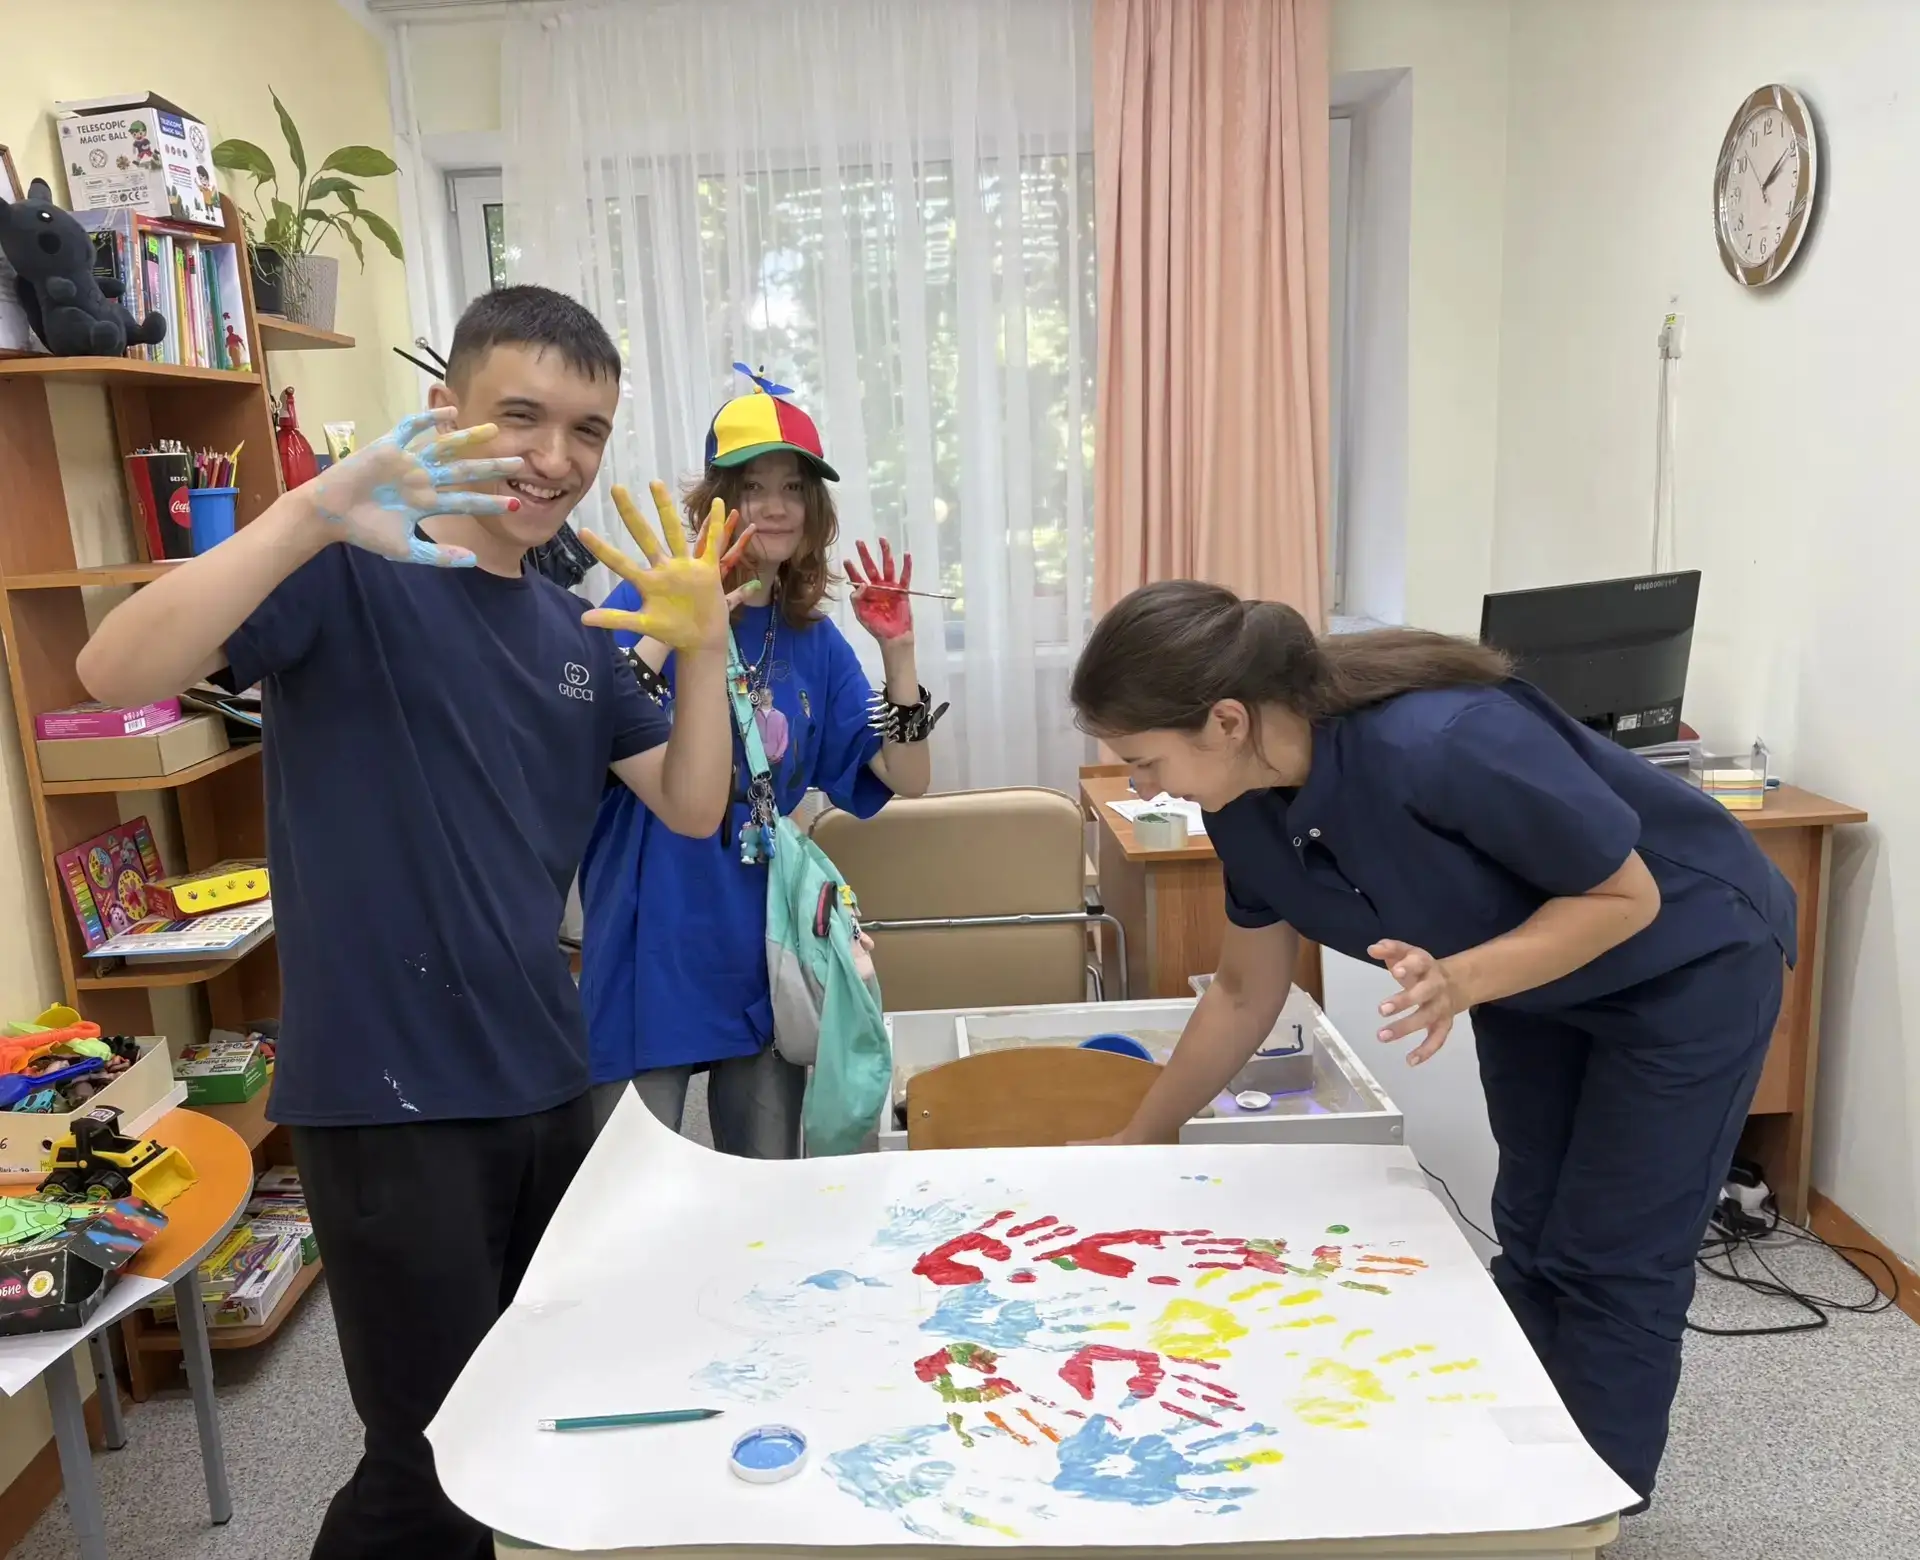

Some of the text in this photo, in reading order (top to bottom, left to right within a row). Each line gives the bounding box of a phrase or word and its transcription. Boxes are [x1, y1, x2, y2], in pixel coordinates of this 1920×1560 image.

[76, 120, 126, 134] TELESCOPIC
[1763, 118, 1773, 136] 12
[80, 131, 128, 144] MAGIC BALL
[1738, 156, 1748, 174] 10
[1785, 200, 1793, 218] 4
[1759, 237, 1767, 255] 6
[558, 682, 594, 702] GUCCI
